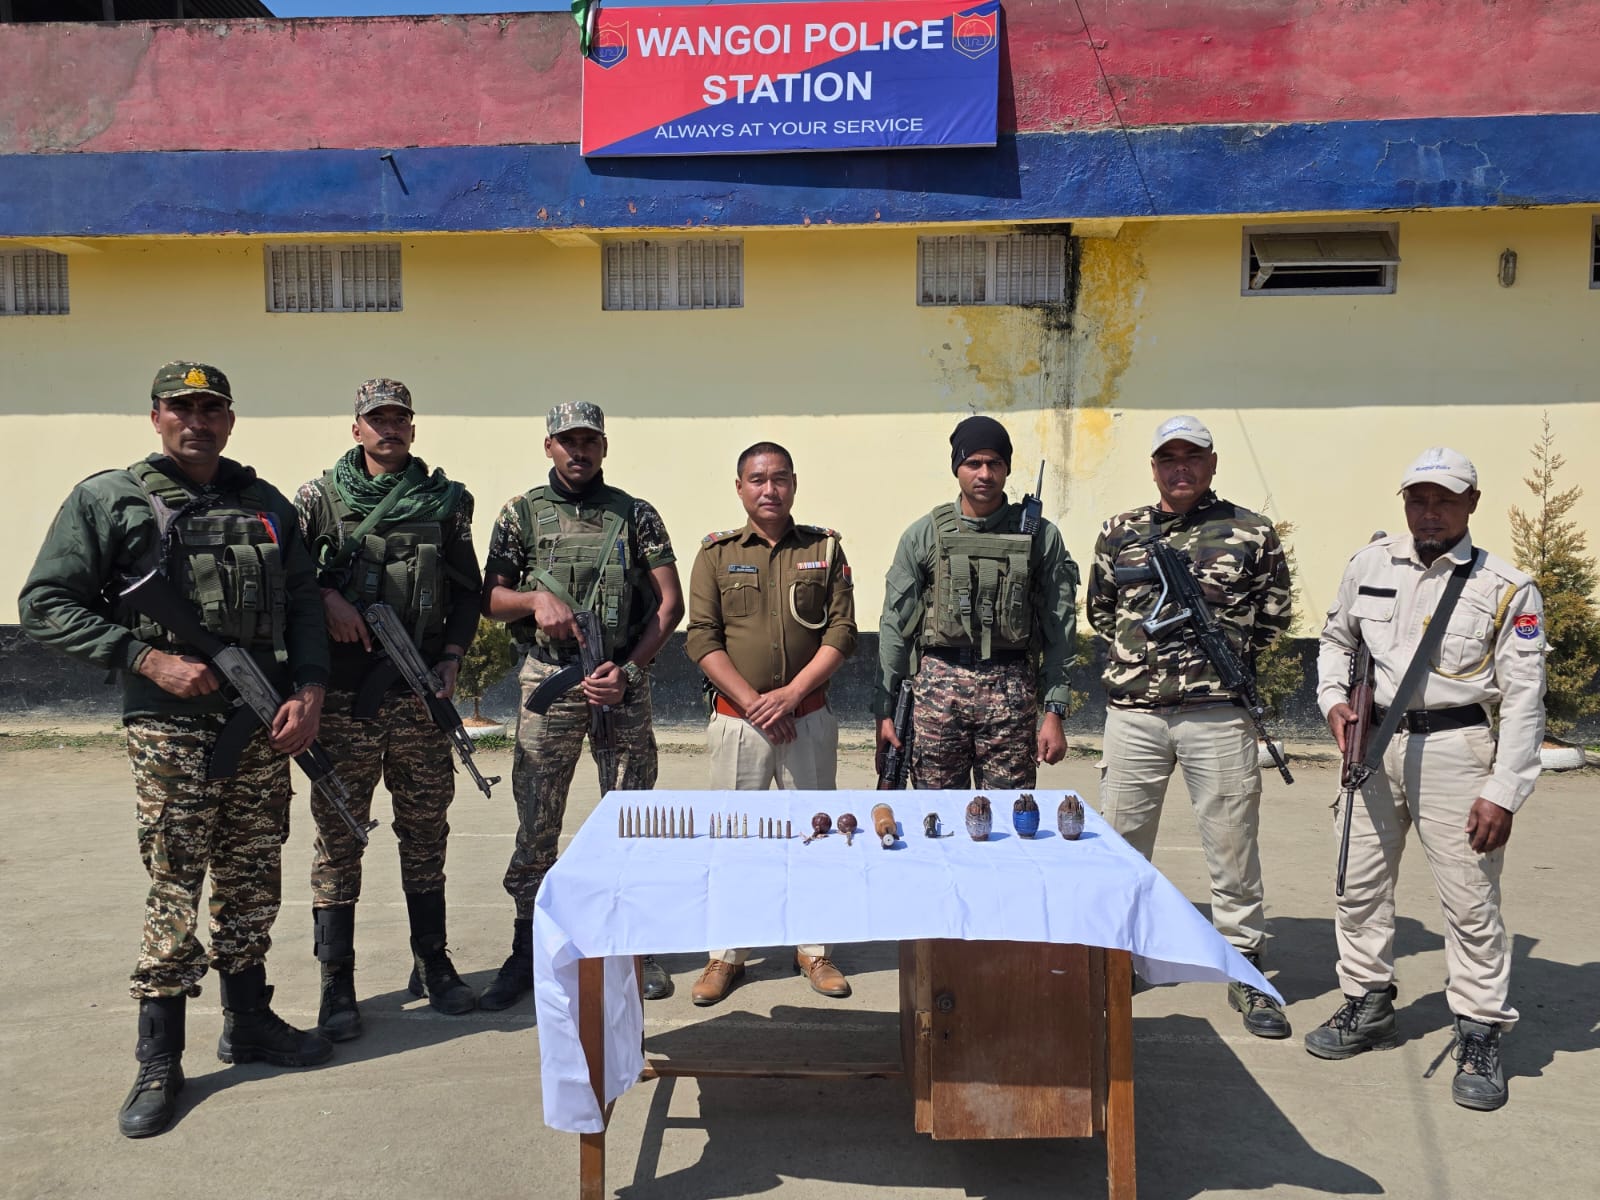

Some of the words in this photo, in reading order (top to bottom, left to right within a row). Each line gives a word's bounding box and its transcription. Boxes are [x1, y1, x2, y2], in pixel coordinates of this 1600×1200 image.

[637, 24, 790, 57] WANGOI
[804, 19, 944, 53] POLICE
[702, 71, 873, 106] STATION
[654, 124, 735, 140] ALWAYS
[738, 122, 764, 138] AT
[767, 121, 827, 137] YOUR
[833, 117, 923, 135] SERVICE
